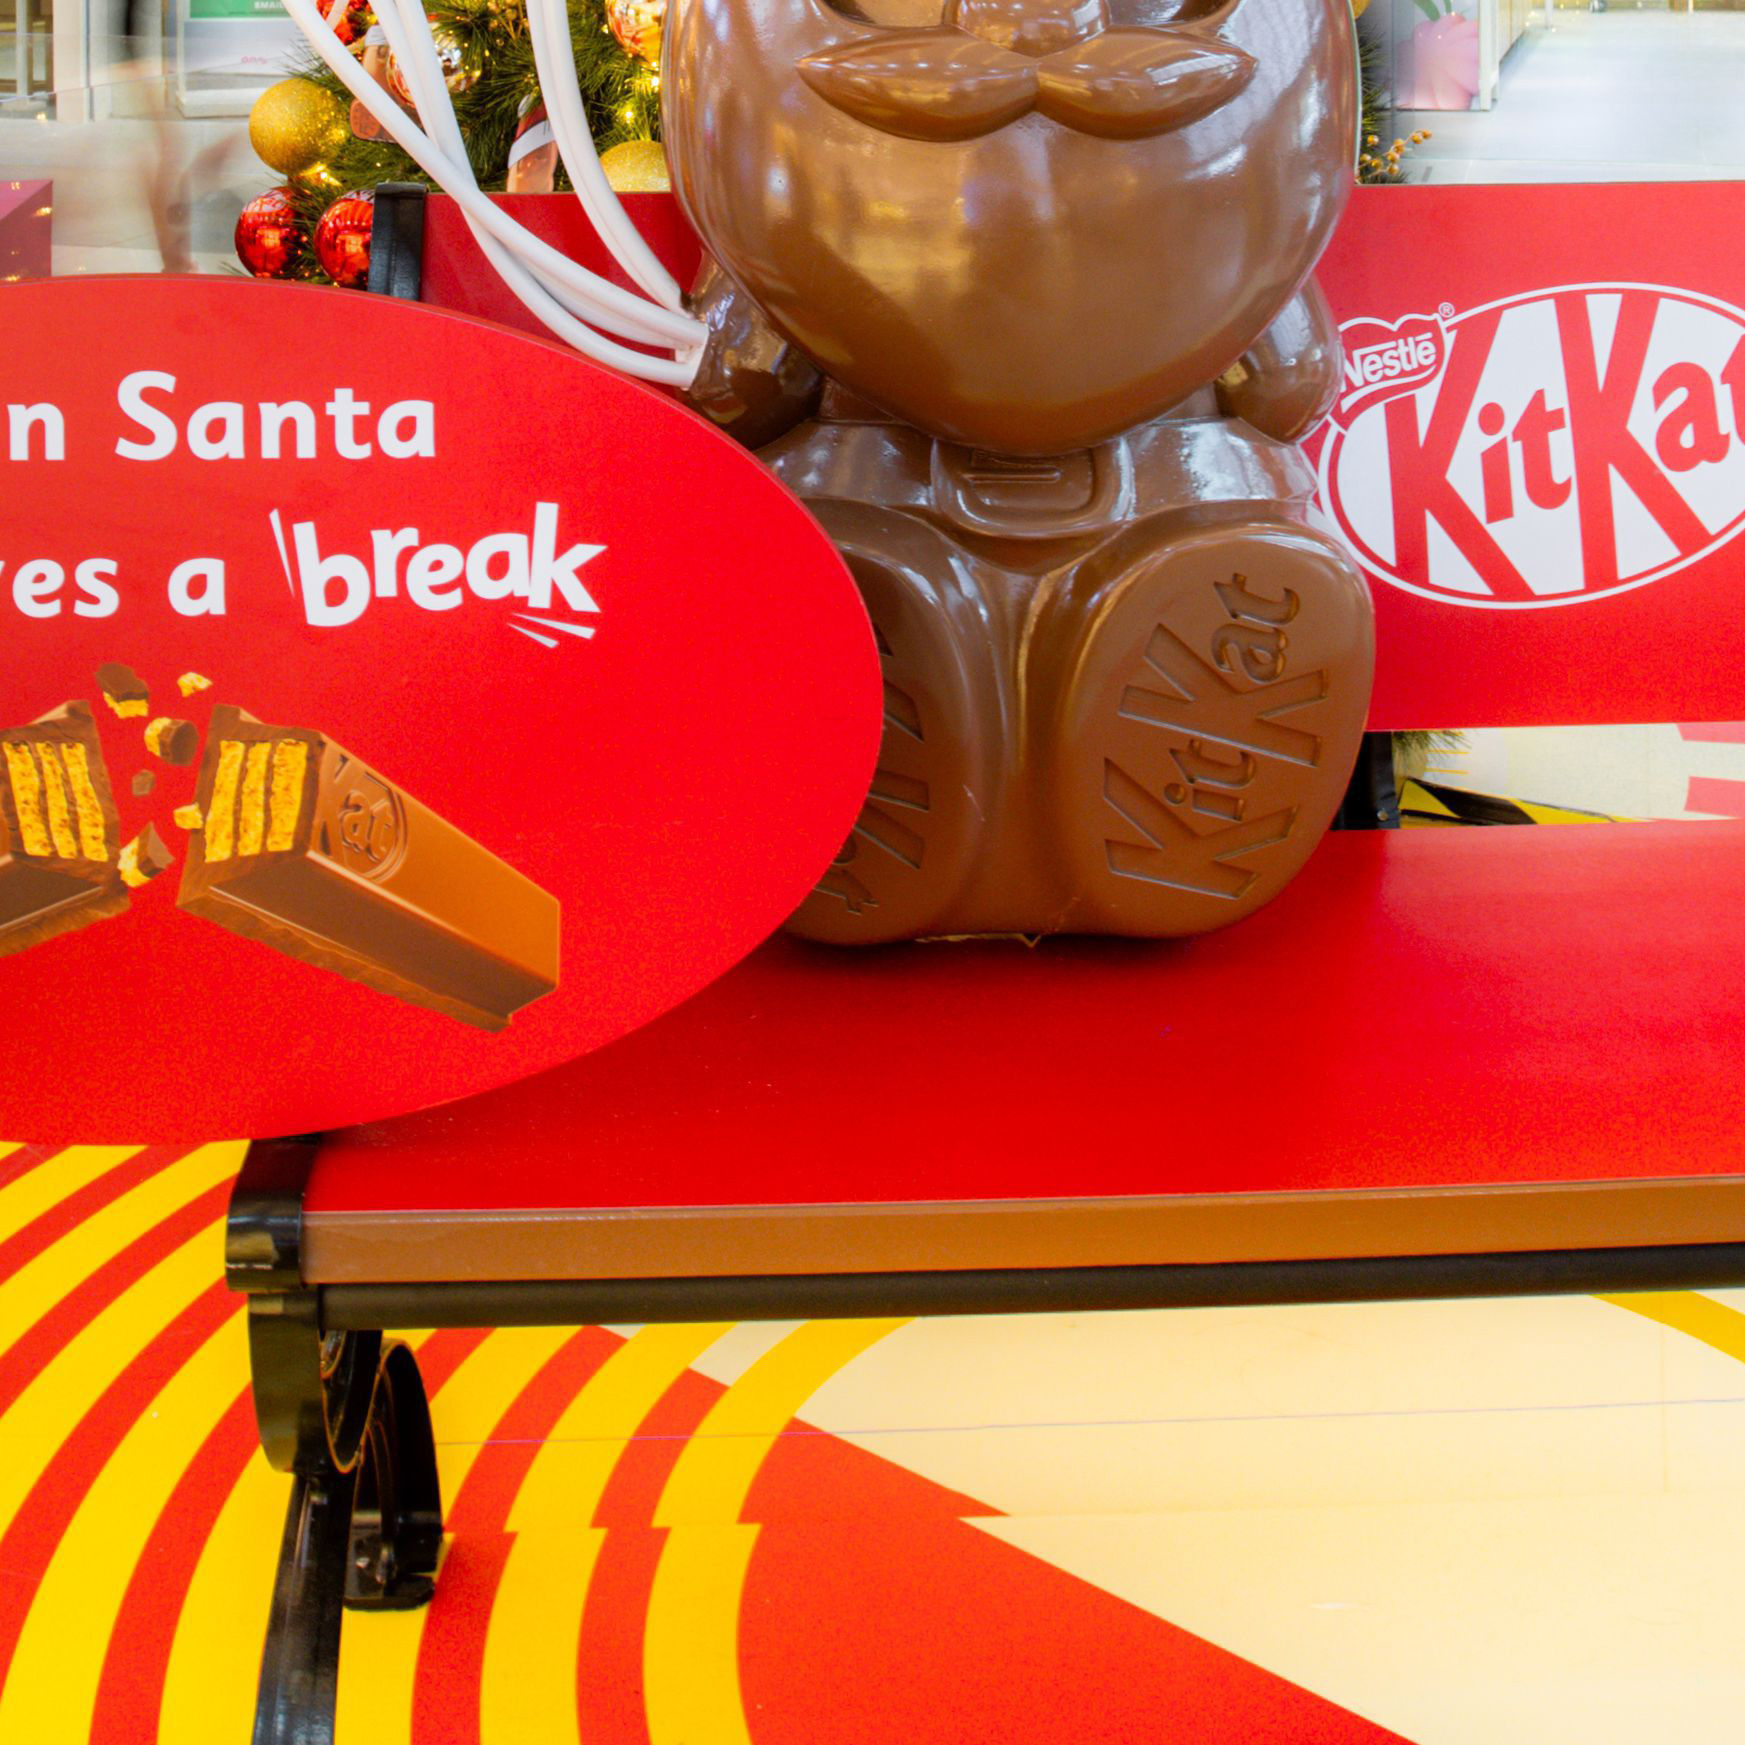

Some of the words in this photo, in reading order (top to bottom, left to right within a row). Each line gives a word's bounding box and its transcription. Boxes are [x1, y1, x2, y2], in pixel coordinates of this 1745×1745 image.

[115, 370, 438, 462] Santa
[167, 556, 228, 617] a
[290, 502, 609, 628] break
[1102, 572, 1329, 901] KitKat
